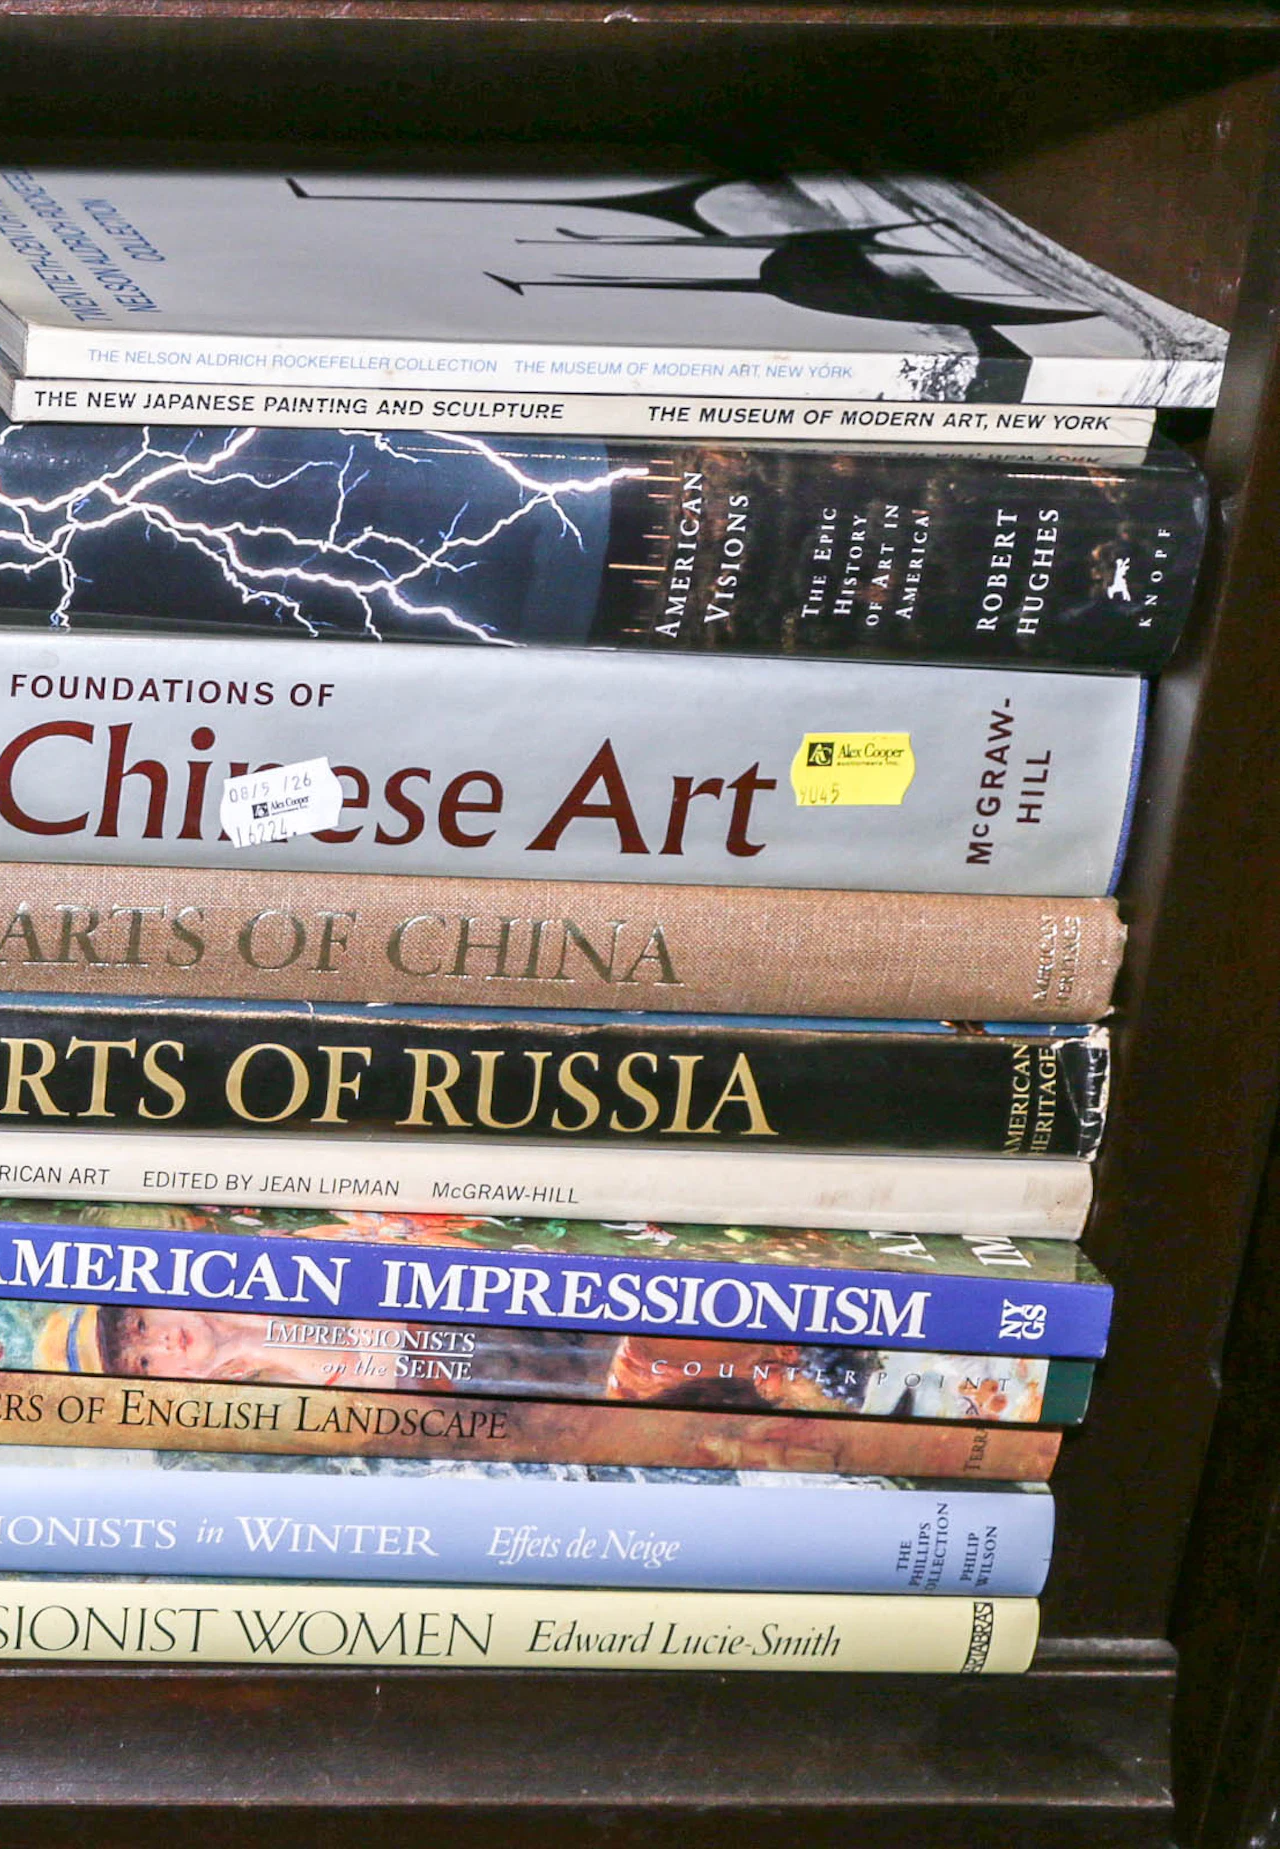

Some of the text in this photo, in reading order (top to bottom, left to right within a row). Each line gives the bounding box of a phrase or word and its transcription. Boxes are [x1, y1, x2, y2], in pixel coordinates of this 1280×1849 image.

[88, 348, 498, 373] THE NELSON ALDRICH ROCKEFELLER COLLECTION
[34, 390, 564, 420] THE NEW JAPANESE PAINTING AND SCULPTURE
[648, 405, 1111, 432] THE MUSEUM OF MODERN ART, NEW YORK
[655, 471, 703, 638] AMERICAN
[703, 494, 749, 623] VISIONS
[801, 507, 837, 618] THE EPIC
[833, 514, 868, 615] HISTORY
[865, 504, 899, 626] OF ART IN
[895, 515, 930, 620] AMERICA
[976, 509, 1018, 631] ROBERT
[1016, 508, 1059, 635] HUGHES
[1138, 528, 1172, 628] KNOPF
[10, 673, 336, 708] FOUNDATIONS OF
[838, 743, 906, 762] Alex Cooper
[1016, 749, 1052, 824] HILL
[525, 737, 779, 857] Art
[239, 907, 358, 975] OF
[385, 912, 685, 988] CHINA
[225, 1042, 372, 1124] OF
[397, 1046, 780, 1137] RUSSIA
[68, 1167, 111, 1186] ART
[431, 1180, 580, 1204] McGRAW-HILL
[263, 1319, 476, 1353] IMPRESSIONISTS
[378, 1257, 932, 1340] IMPRESSIONISM
[650, 1359, 1012, 1392] COUNTERPOINT
[196, 1521, 225, 1546] in
[239, 1515, 439, 1557] WINTER
[486, 1524, 681, 1571] Effets de Neige
[232, 1608, 493, 1658] WOMEN
[525, 1621, 652, 1656] Edward
[659, 1623, 841, 1660] Lucie-Smith
